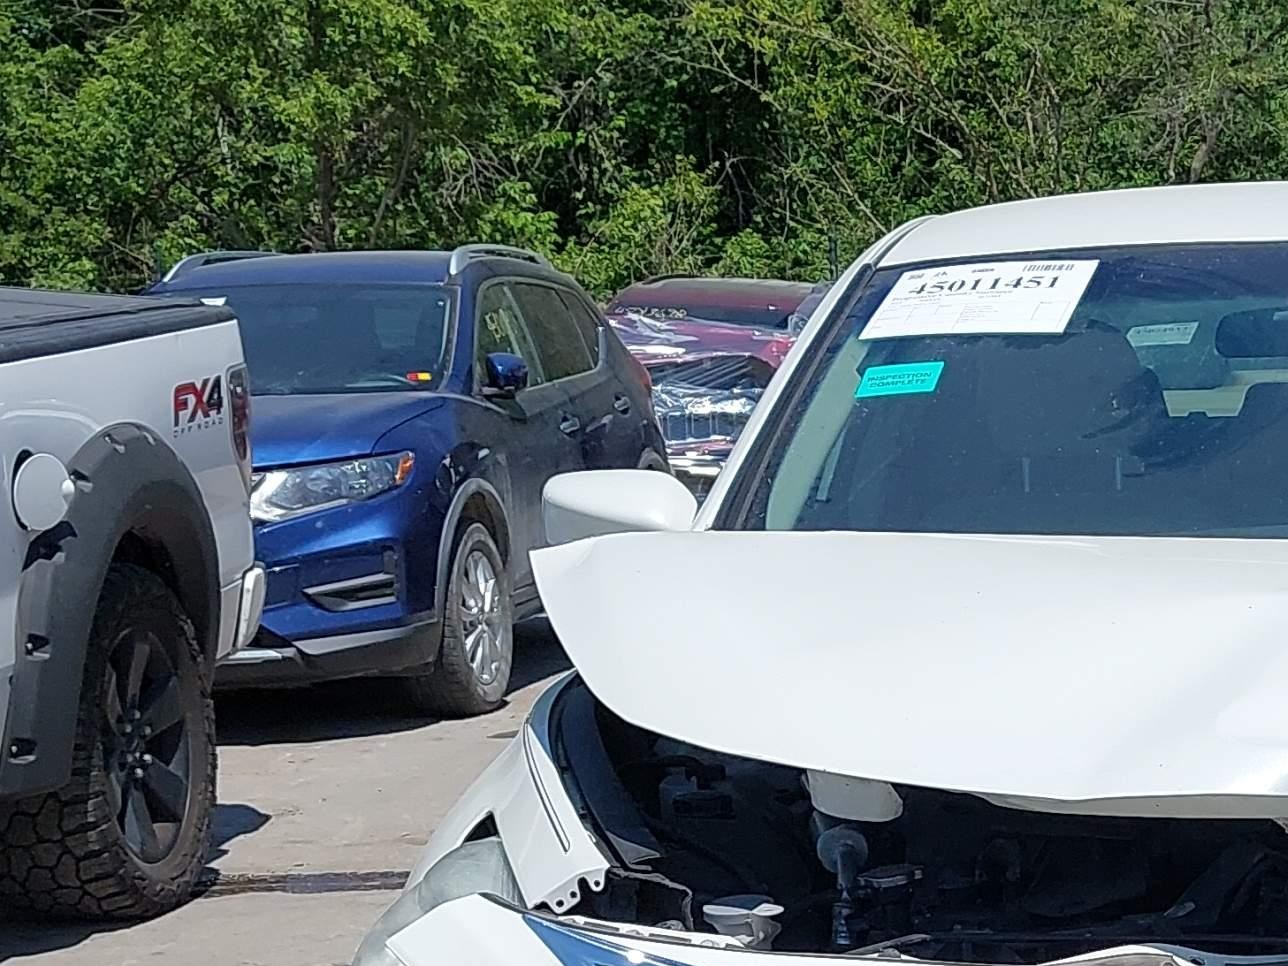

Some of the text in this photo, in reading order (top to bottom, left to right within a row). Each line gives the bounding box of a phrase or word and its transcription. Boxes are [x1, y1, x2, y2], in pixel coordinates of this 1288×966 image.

[908, 275, 1060, 295] 45011451
[867, 371, 932, 383] INSPECTION
[869, 378, 928, 388] COMPLETE
[174, 374, 223, 427] FX4
[173, 417, 224, 438] OFF ROAD
